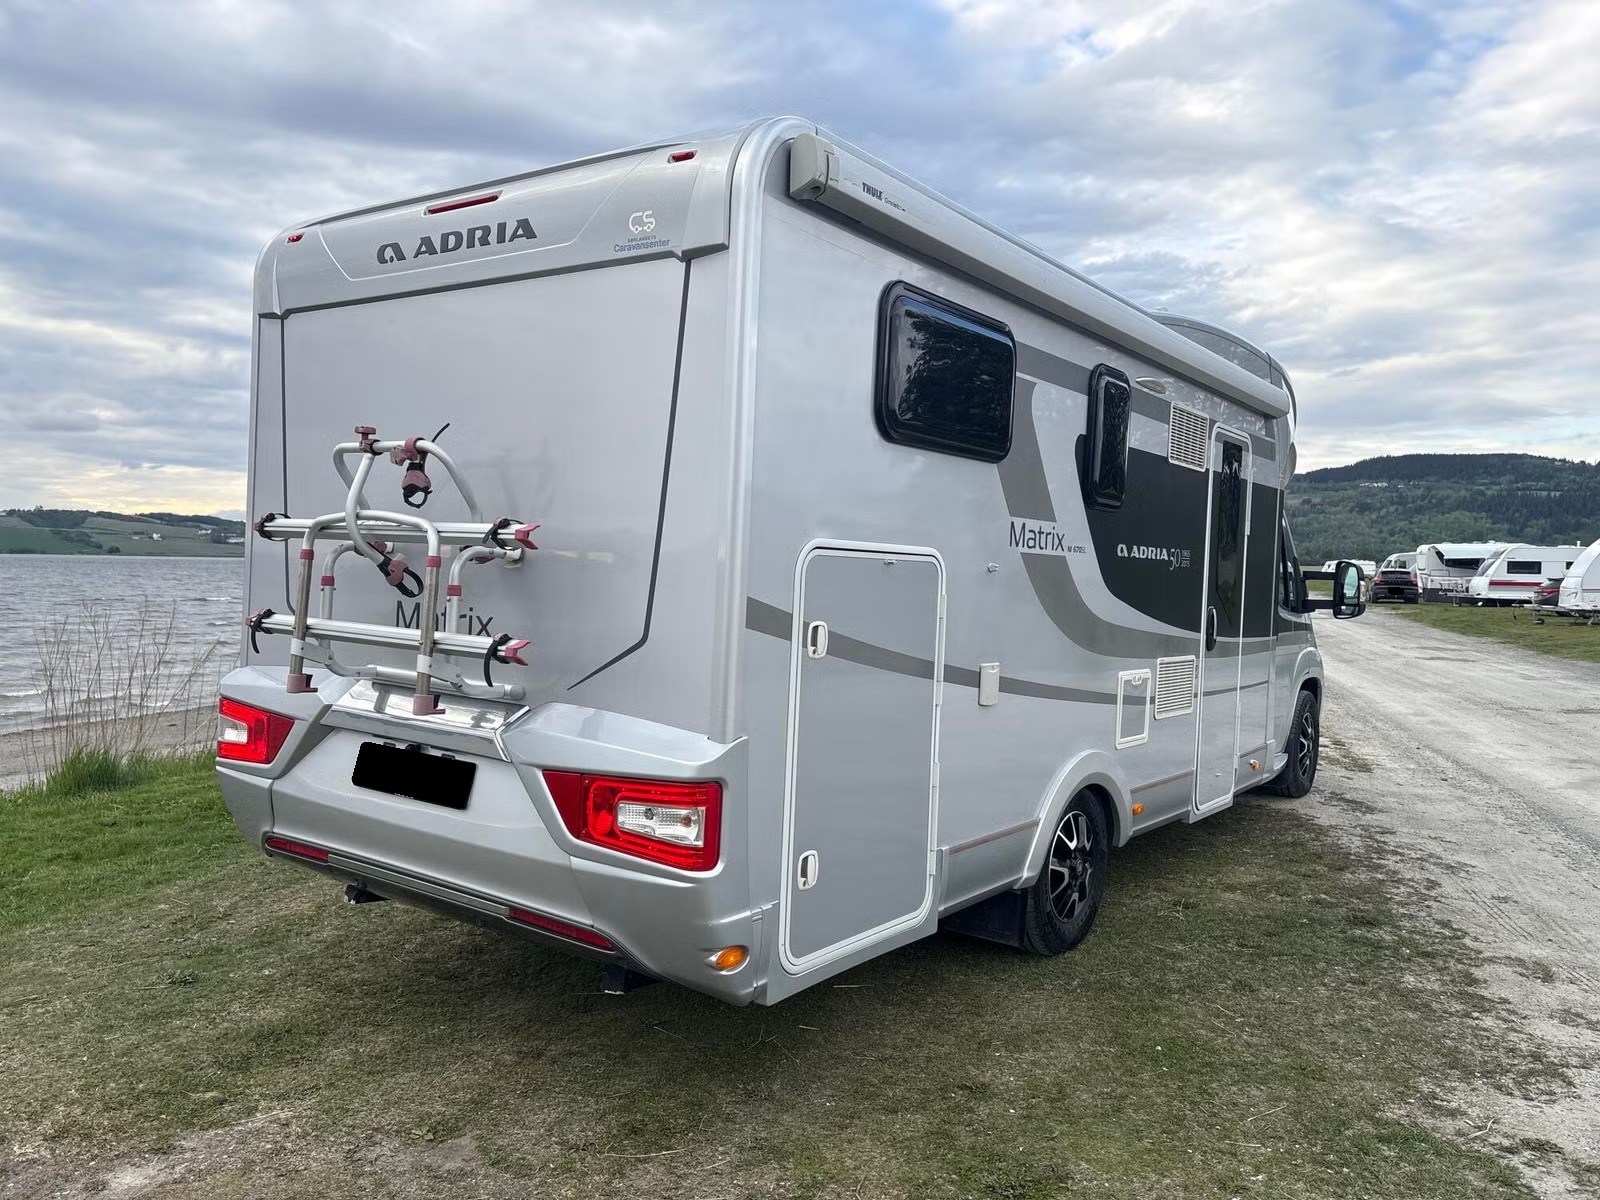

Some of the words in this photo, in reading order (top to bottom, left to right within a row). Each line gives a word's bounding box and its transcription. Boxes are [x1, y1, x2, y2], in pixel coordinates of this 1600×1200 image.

[862, 181, 883, 201] THULE
[413, 218, 537, 258] ADRIA
[613, 239, 671, 253] Caravansenter
[1009, 520, 1065, 552] Matrix
[1130, 545, 1169, 560] ADRIA
[1169, 548, 1181, 571] 50
